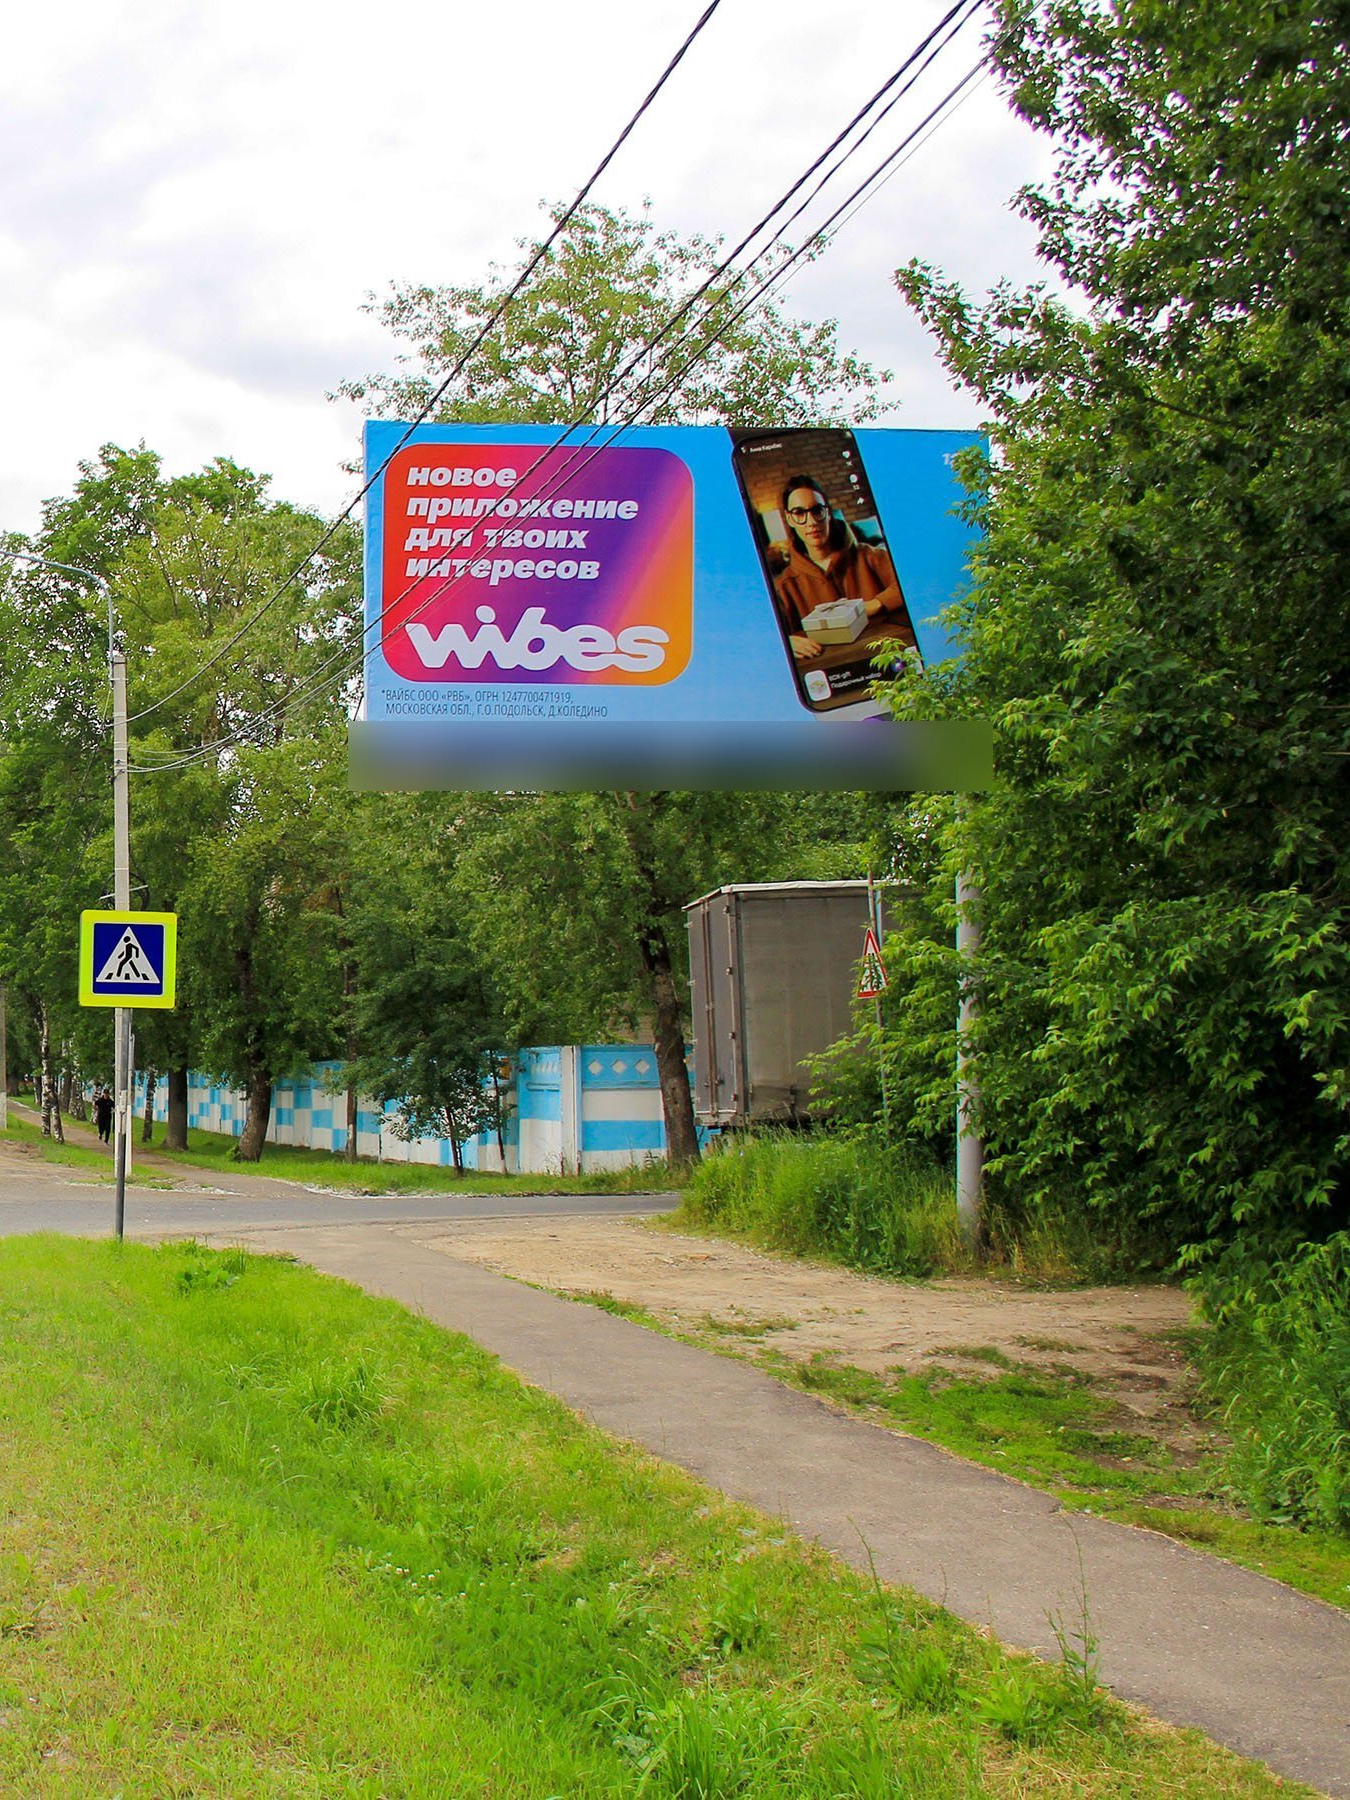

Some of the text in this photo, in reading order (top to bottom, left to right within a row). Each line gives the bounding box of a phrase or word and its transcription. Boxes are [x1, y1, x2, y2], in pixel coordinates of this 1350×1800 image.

[406, 467, 517, 487] новое
[406, 497, 639, 524] приложение
[404, 528, 589, 551] для твоих
[405, 558, 600, 586] интересов
[405, 605, 670, 672] wibes
[418, 690, 439, 702] ООО
[475, 691, 499, 702] ОГРН
[386, 703, 447, 715] МОСКОВСКАЯ
[548, 704, 608, 719] Д.КОЛЕДИНО
